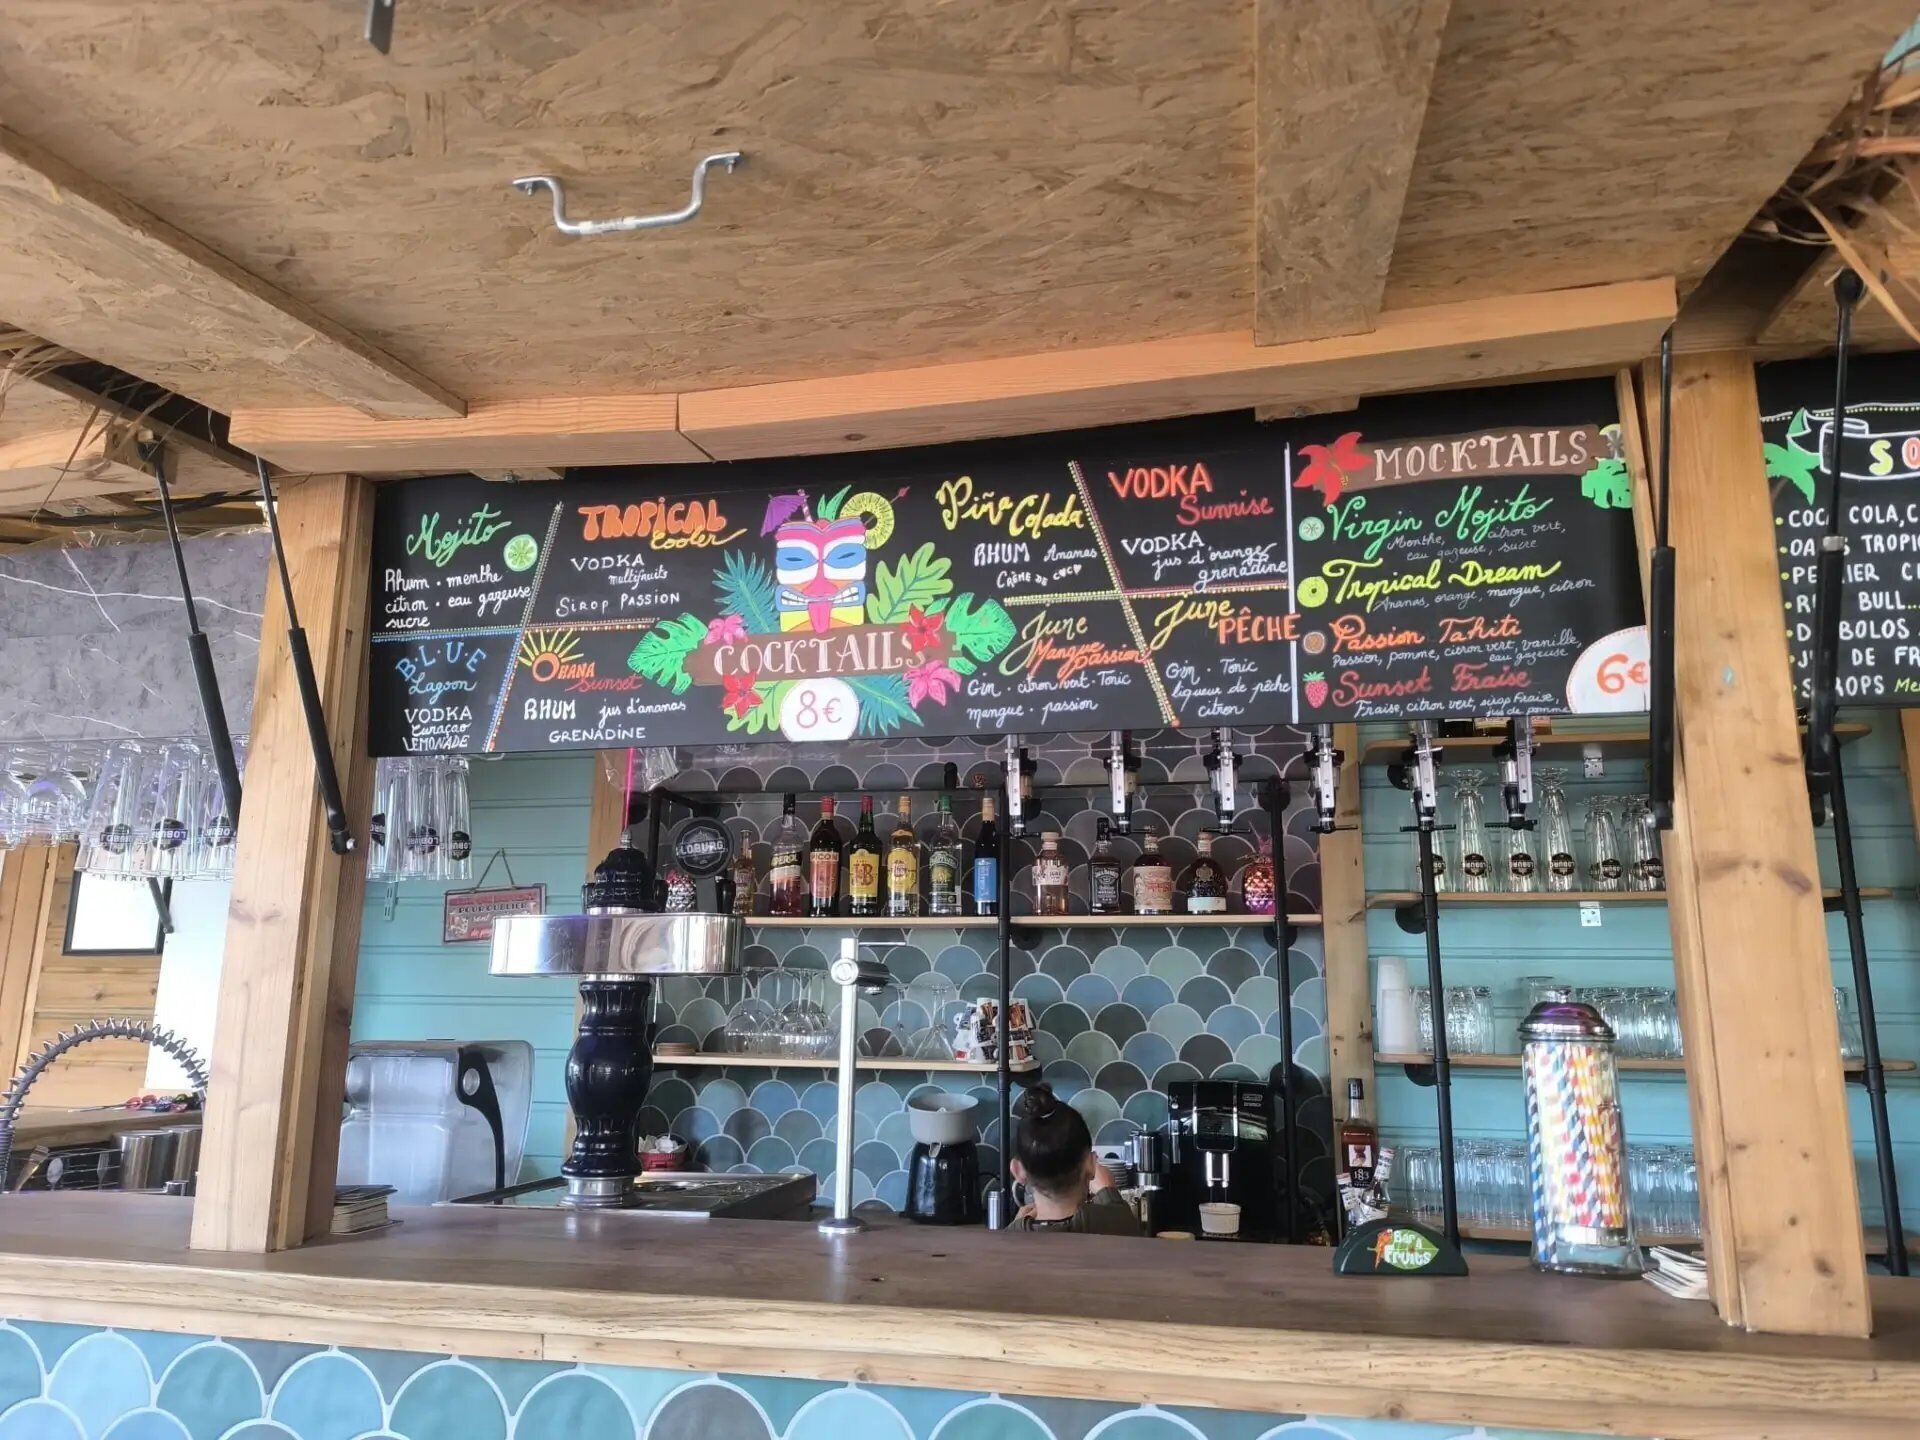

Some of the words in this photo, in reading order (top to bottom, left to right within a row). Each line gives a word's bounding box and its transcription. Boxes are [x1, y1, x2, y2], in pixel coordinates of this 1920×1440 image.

[1374, 430, 1589, 481] MOCKTAILS
[1108, 462, 1213, 498] VODKA
[1176, 489, 1274, 525] Sunrise
[1788, 508, 1829, 527] COC
[406, 503, 512, 567] Mojito
[1327, 496, 1423, 560] Virgin
[1435, 484, 1554, 543] Mojito
[650, 524, 748, 550] Cooler
[1121, 530, 1205, 555] VODKA
[1406, 550, 1430, 560] eau
[1498, 539, 1538, 552] sucre
[1861, 533, 1920, 553] TROPI
[570, 553, 645, 571] VODKA
[973, 542, 1031, 568] RHUM
[1043, 543, 1098, 562] Ananas
[1152, 555, 1181, 581] jus
[385, 569, 429, 592] Rhum
[446, 564, 503, 587] menthe
[1194, 560, 1288, 593] grenadine
[1322, 558, 1442, 613] Tropical
[1448, 560, 1562, 588] Dream
[1549, 578, 1596, 594] citron
[1792, 563, 1880, 584] PEIER
[1901, 562, 1920, 581] C
[385, 595, 429, 614] citron
[448, 595, 473, 608] eau
[477, 586, 532, 616] gazeuse
[386, 615, 430, 629] sucre
[1219, 606, 1301, 645] PÊCHE
[1329, 615, 1425, 652] Passion
[1439, 613, 1521, 643] Tahiti
[1796, 618, 1910, 641] DBOLOS
[999, 602, 1089, 676] June
[1445, 642, 1482, 657] citron
[1521, 628, 1582, 650] vanille,
[714, 631, 925, 676] COCKTAILS
[1852, 648, 1875, 666] DE
[565, 675, 644, 694] Sunset
[968, 673, 1001, 697] Gin
[1018, 674, 1058, 695] citron
[1097, 670, 1132, 686] Tonic
[1166, 660, 1200, 685] Gin
[1220, 658, 1258, 674] Tonic
[1332, 665, 1433, 706] Sunset
[1452, 662, 1532, 691] Fraise
[1597, 654, 1648, 694] 6€
[408, 672, 478, 705] Lagoon
[1227, 677, 1247, 694] de
[1249, 674, 1291, 703] pêche
[1802, 675, 1885, 697] SROPS
[404, 705, 473, 724] VODKA
[524, 699, 576, 720] RHUM
[598, 704, 620, 728] jus
[626, 698, 687, 714] d'ananas
[796, 690, 842, 729] 8€
[967, 705, 1024, 728] mangue
[1042, 698, 1098, 726] passion
[1198, 697, 1244, 717] citron
[1406, 697, 1445, 712] citron
[1507, 706, 1523, 715] de
[402, 735, 470, 751] LEMONADE
[411, 722, 472, 738] Curaçao
[680, 841, 724, 855] LOBURG
